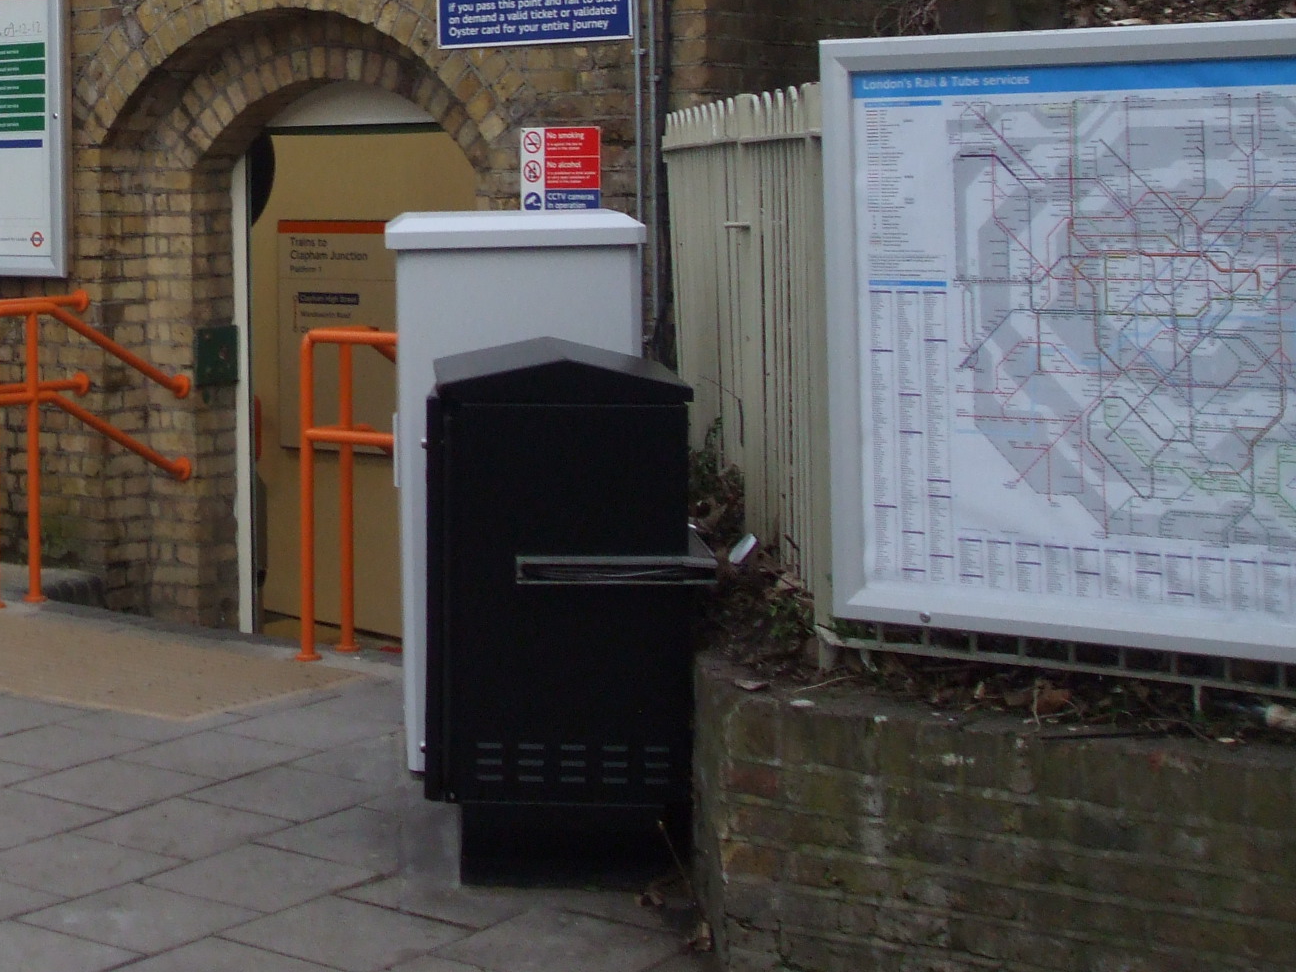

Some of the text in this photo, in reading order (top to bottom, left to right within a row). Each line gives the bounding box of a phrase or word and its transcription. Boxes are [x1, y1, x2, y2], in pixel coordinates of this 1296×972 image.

[458, 4, 474, 14] you
[476, 2, 496, 12] pass
[498, 0, 516, 9] this
[448, 16, 460, 24] on
[462, 12, 497, 23] demand
[506, 10, 528, 20] valid
[530, 10, 558, 19] ticket
[573, 6, 616, 16] validated
[448, 20, 608, 38] Oyster card for your entire journey
[863, 74, 1030, 90] London's Rail & Tube services
[558, 132, 584, 140] smoking
[290, 237, 327, 247] Trains to
[290, 250, 368, 262] Clapham Junction
